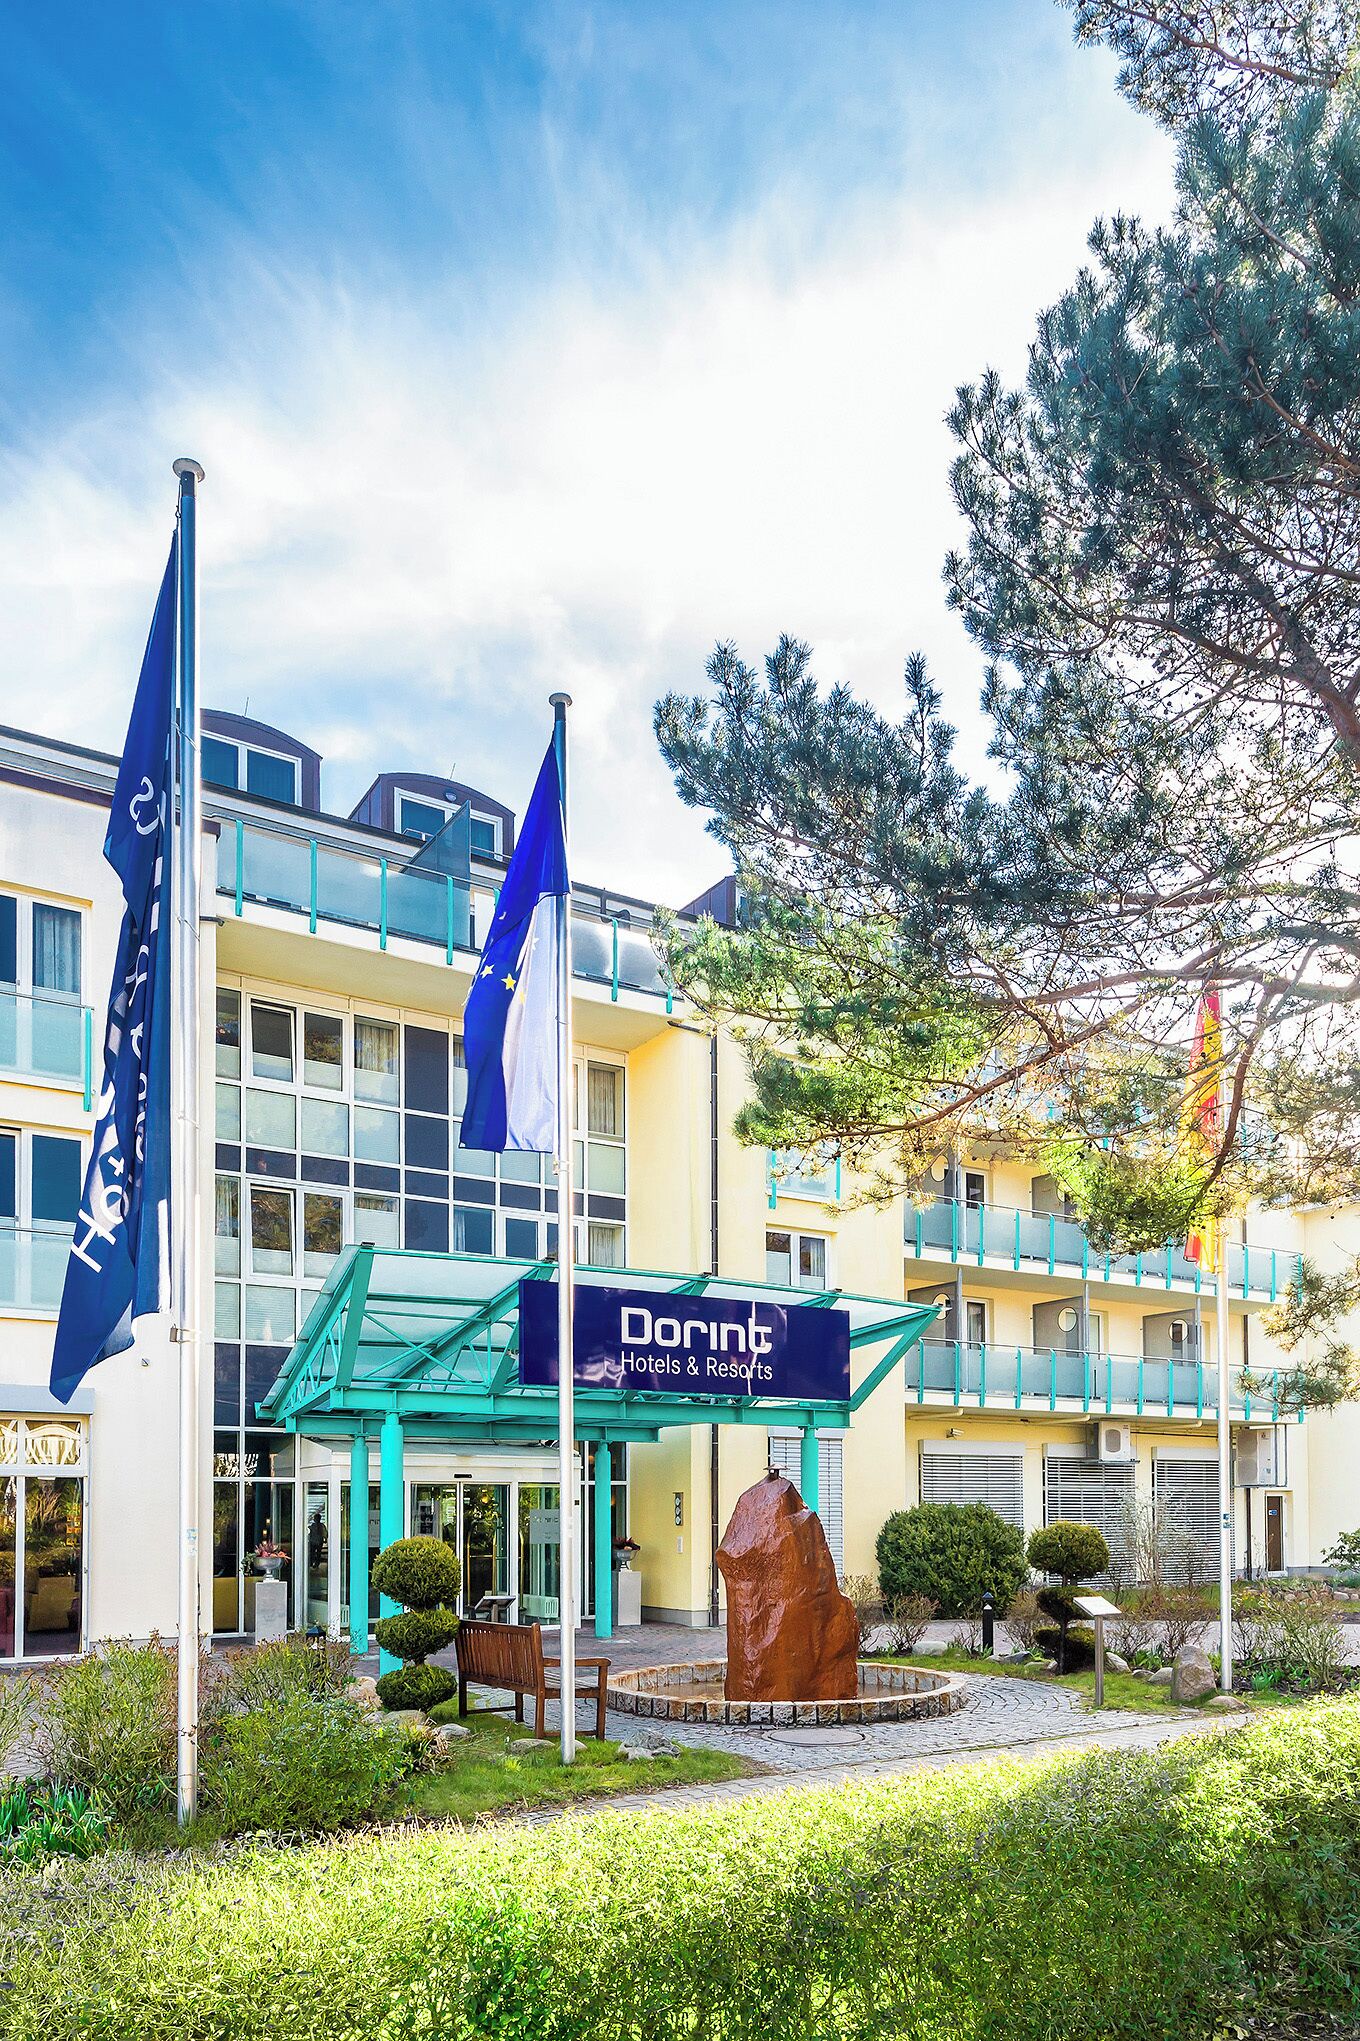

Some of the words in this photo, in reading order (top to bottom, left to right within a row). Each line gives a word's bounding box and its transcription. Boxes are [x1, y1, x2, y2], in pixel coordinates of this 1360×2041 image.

[620, 1306, 773, 1354] Dorint
[621, 1350, 681, 1375] Hotels
[686, 1355, 700, 1376] &
[706, 1356, 773, 1381] Resorts
